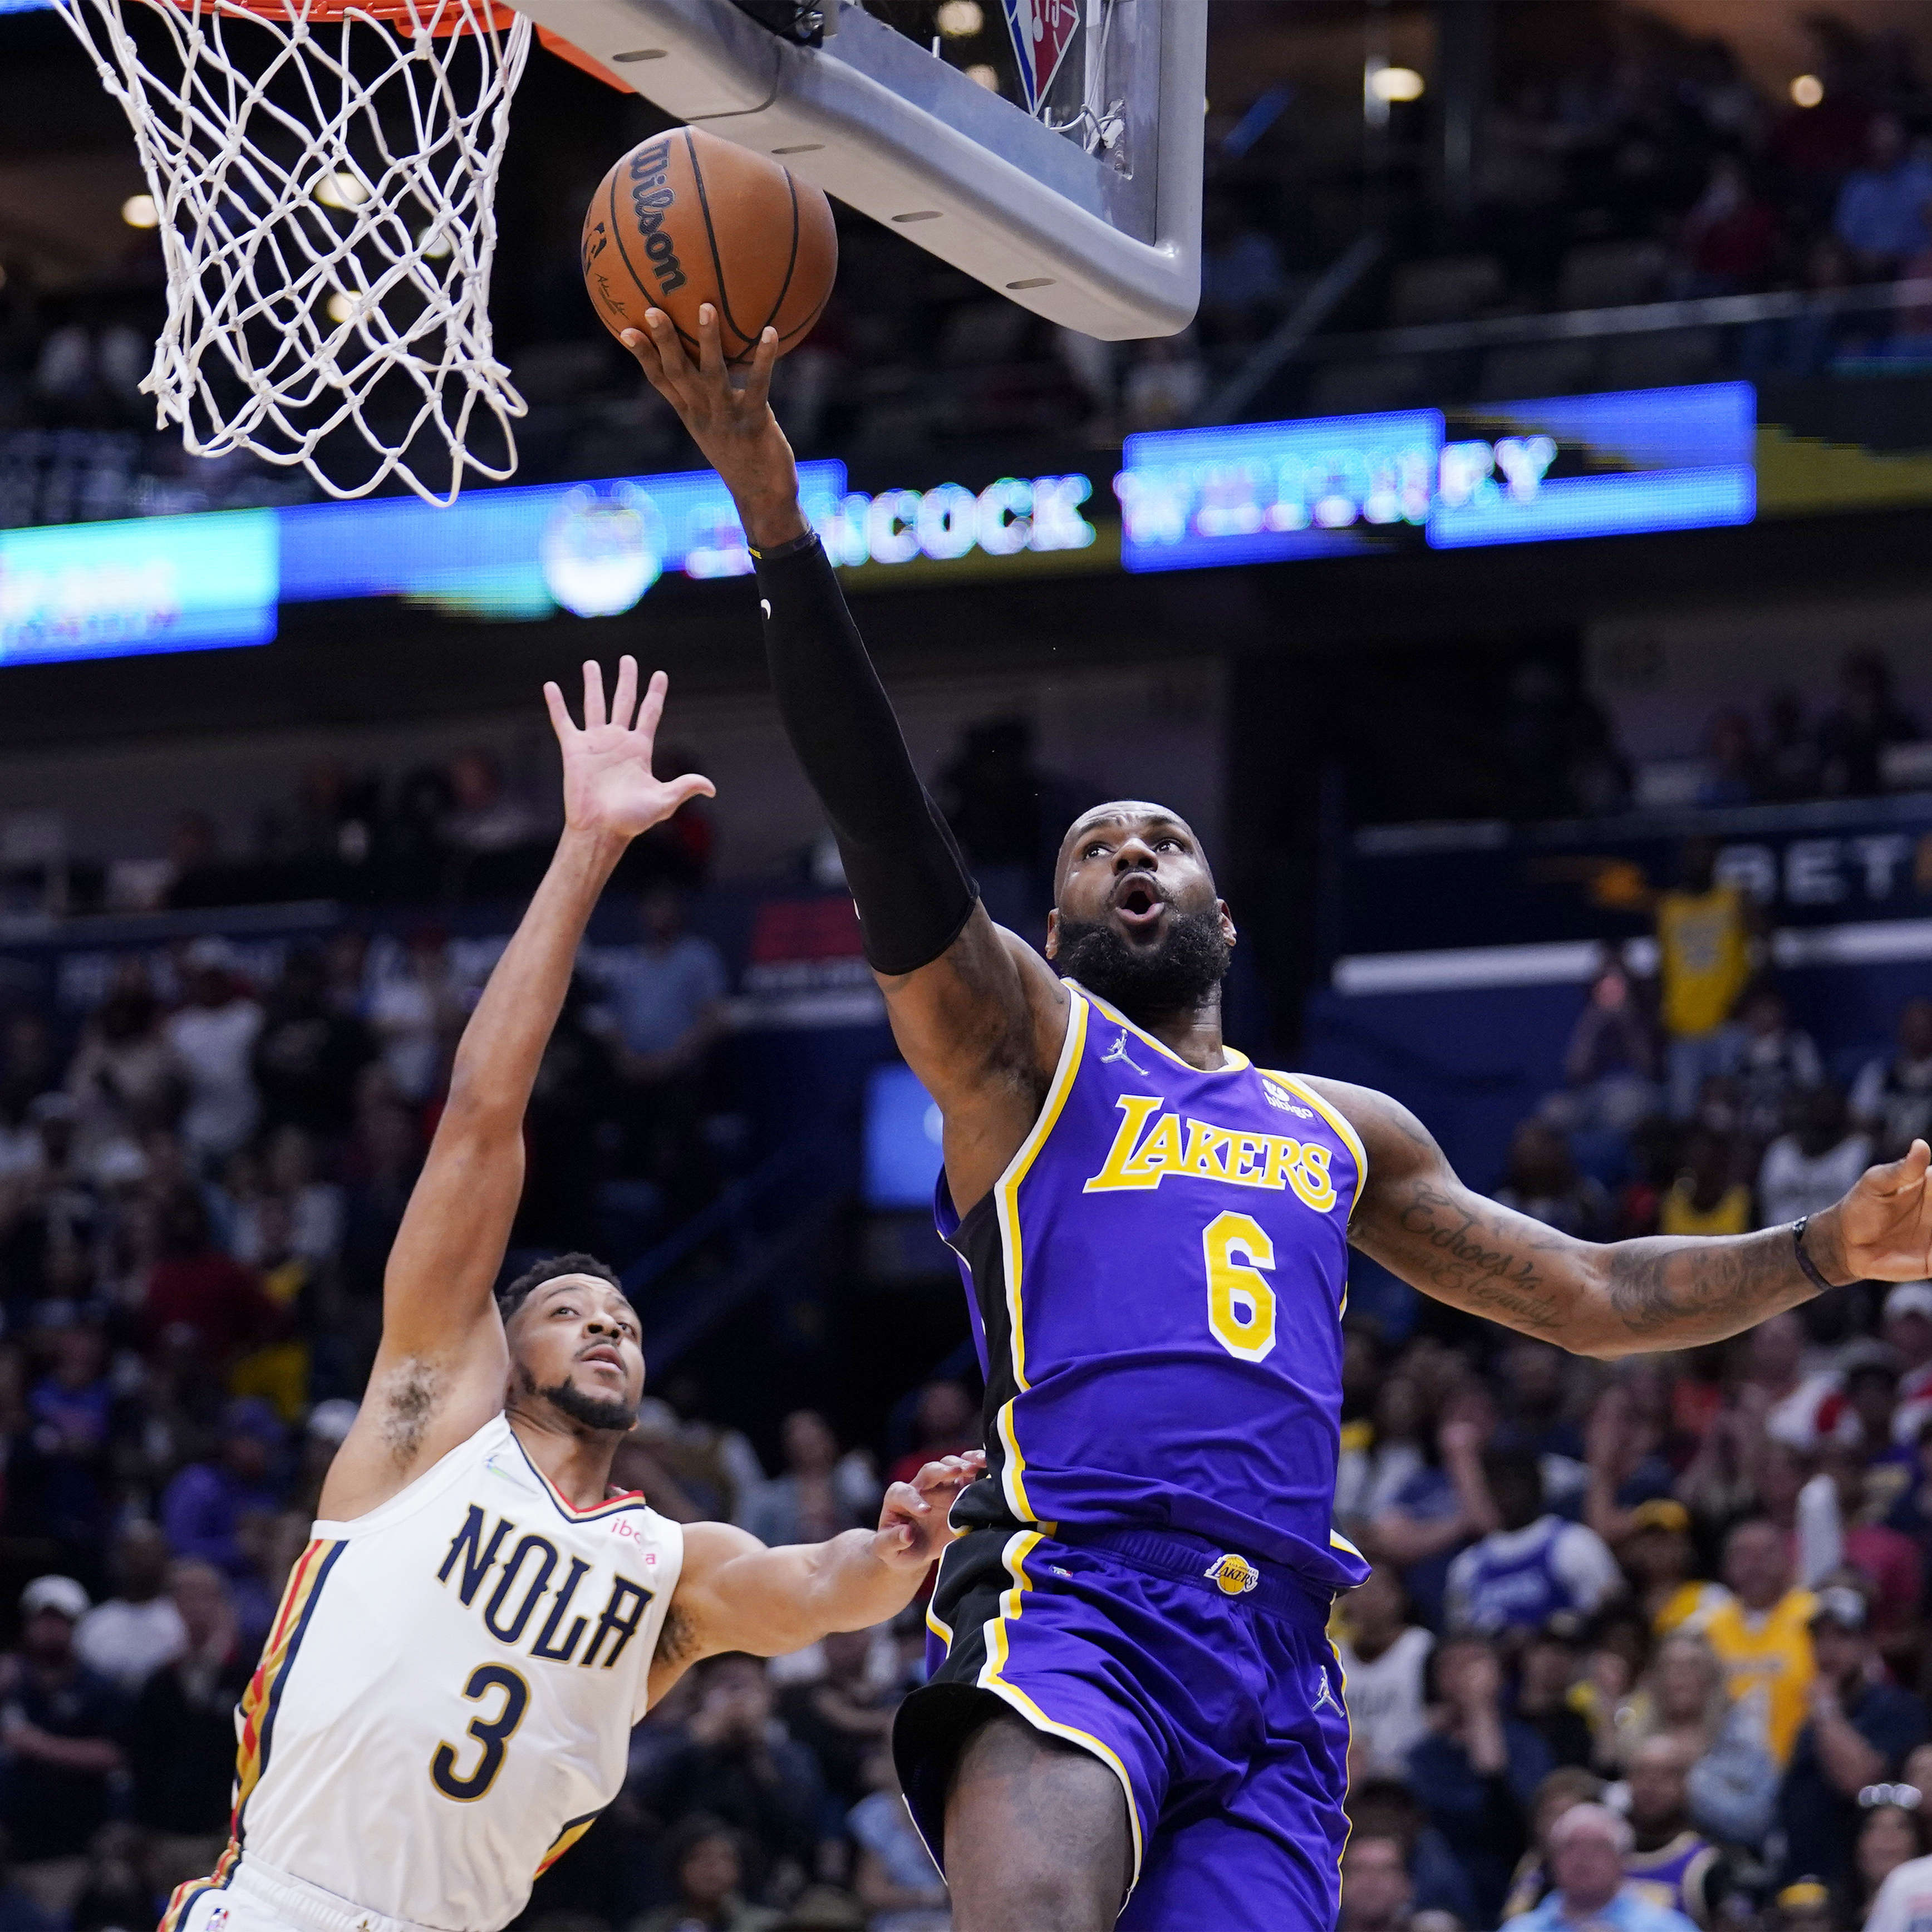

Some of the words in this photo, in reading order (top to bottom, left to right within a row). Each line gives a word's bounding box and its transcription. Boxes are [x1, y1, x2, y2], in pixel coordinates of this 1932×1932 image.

[630, 137, 687, 297] Wilson
[1082, 1094, 1337, 1213] LAKERS
[1264, 1091, 1314, 1119] bibigo
[1202, 1210, 1276, 1363] 6
[435, 1502, 656, 1669] NOLA
[1205, 1559, 1257, 1590] LAKERS
[429, 1661, 531, 1803] 3
